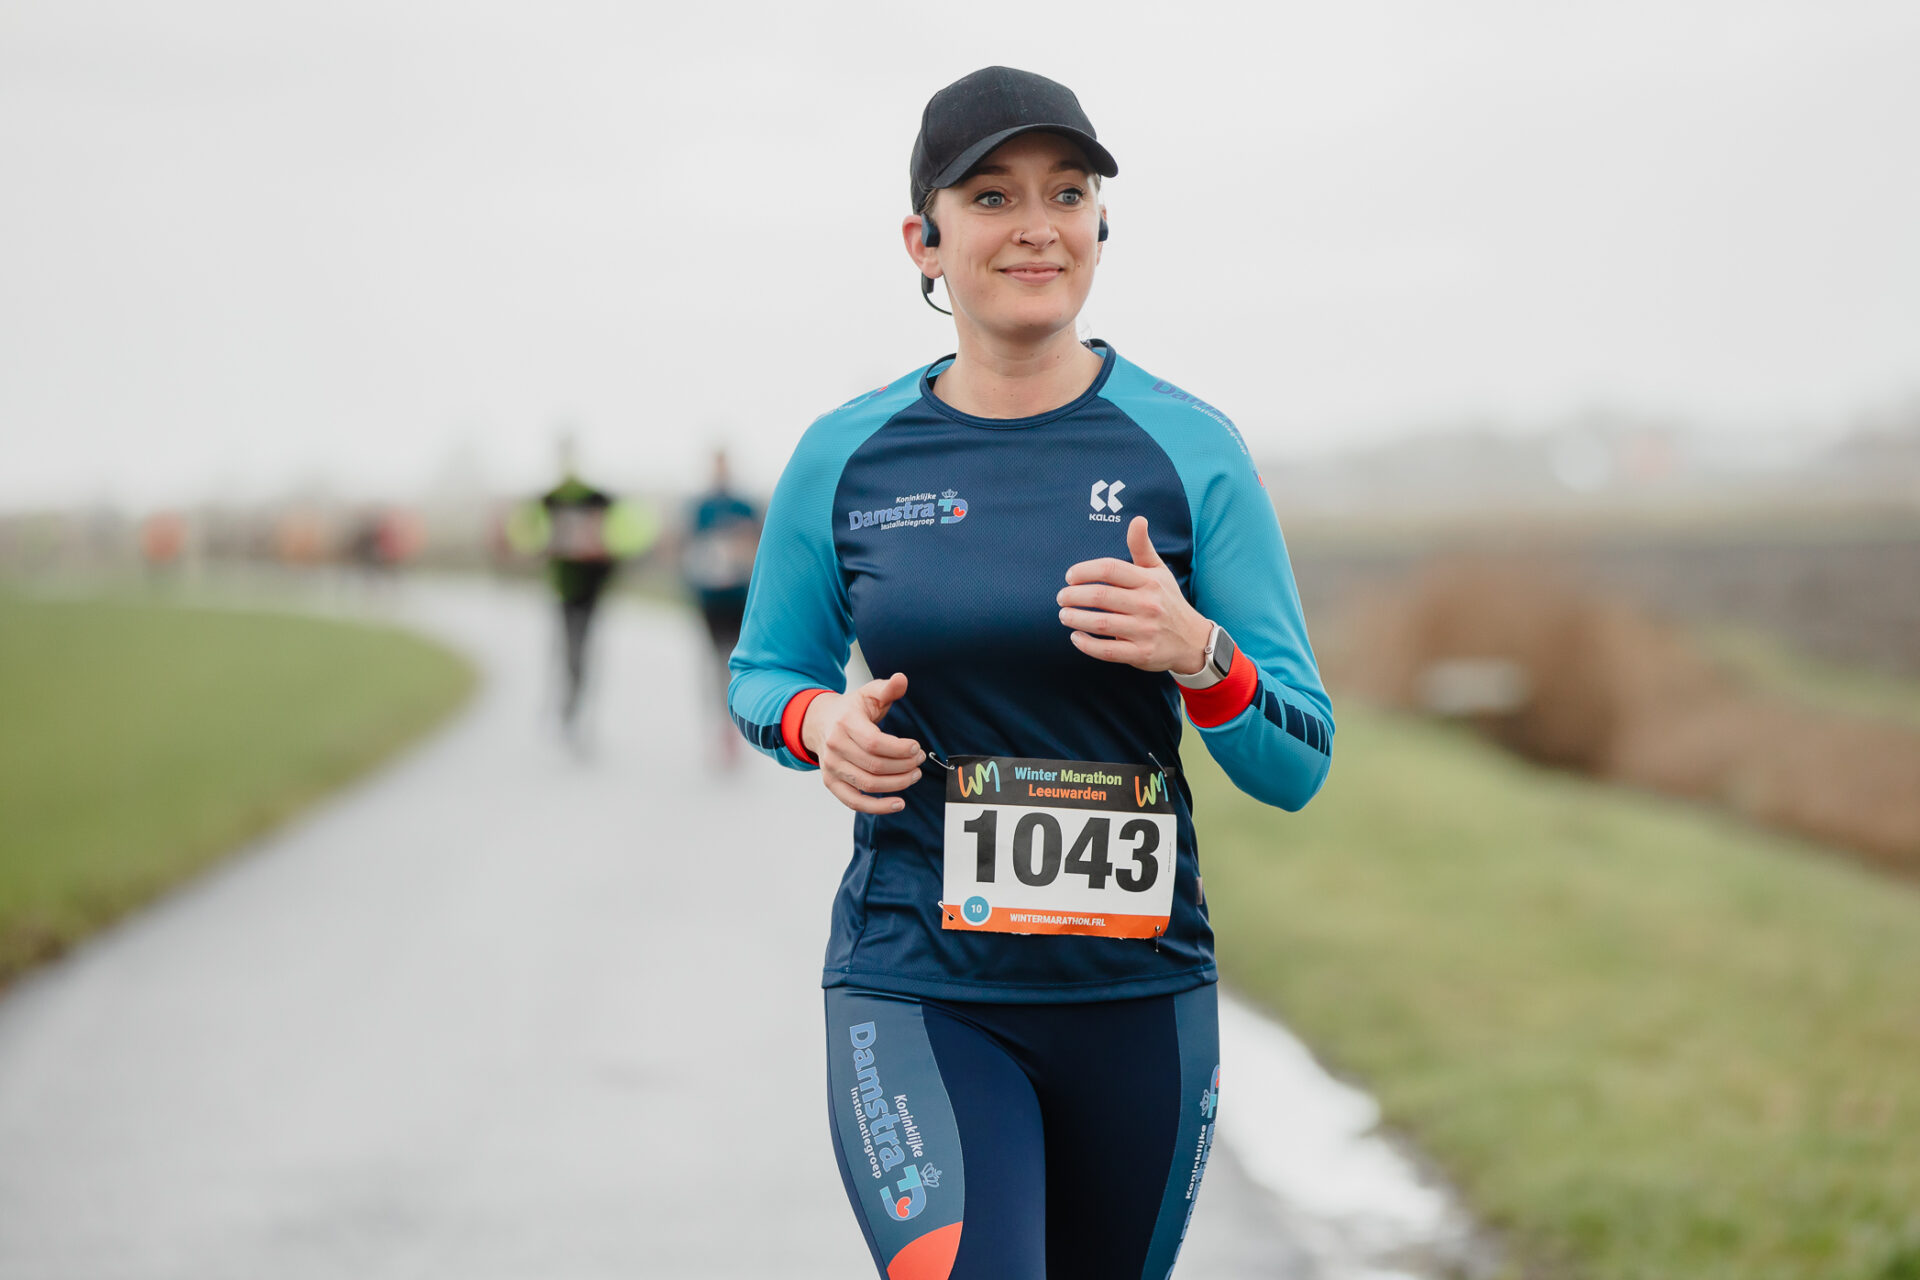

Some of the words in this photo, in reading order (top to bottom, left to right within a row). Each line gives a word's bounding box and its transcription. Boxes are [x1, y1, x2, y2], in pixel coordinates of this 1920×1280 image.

[895, 492, 937, 504] Koninklijke
[848, 501, 936, 531] Damstra
[880, 518, 935, 531] Installatiegroep
[1014, 766, 1058, 781] Winter
[1060, 769, 1122, 785] Marathon
[1028, 783, 1107, 801] Leeuwarden
[963, 809, 1160, 893] 1043
[971, 904, 983, 914] 10
[1009, 913, 1107, 927] WINTERMARATHON.FRL
[849, 1021, 906, 1173] Damstra
[850, 1087, 882, 1179] Installatiegroep
[893, 1094, 924, 1158] Koninklijke
[1185, 1124, 1207, 1199] Koninklijke
